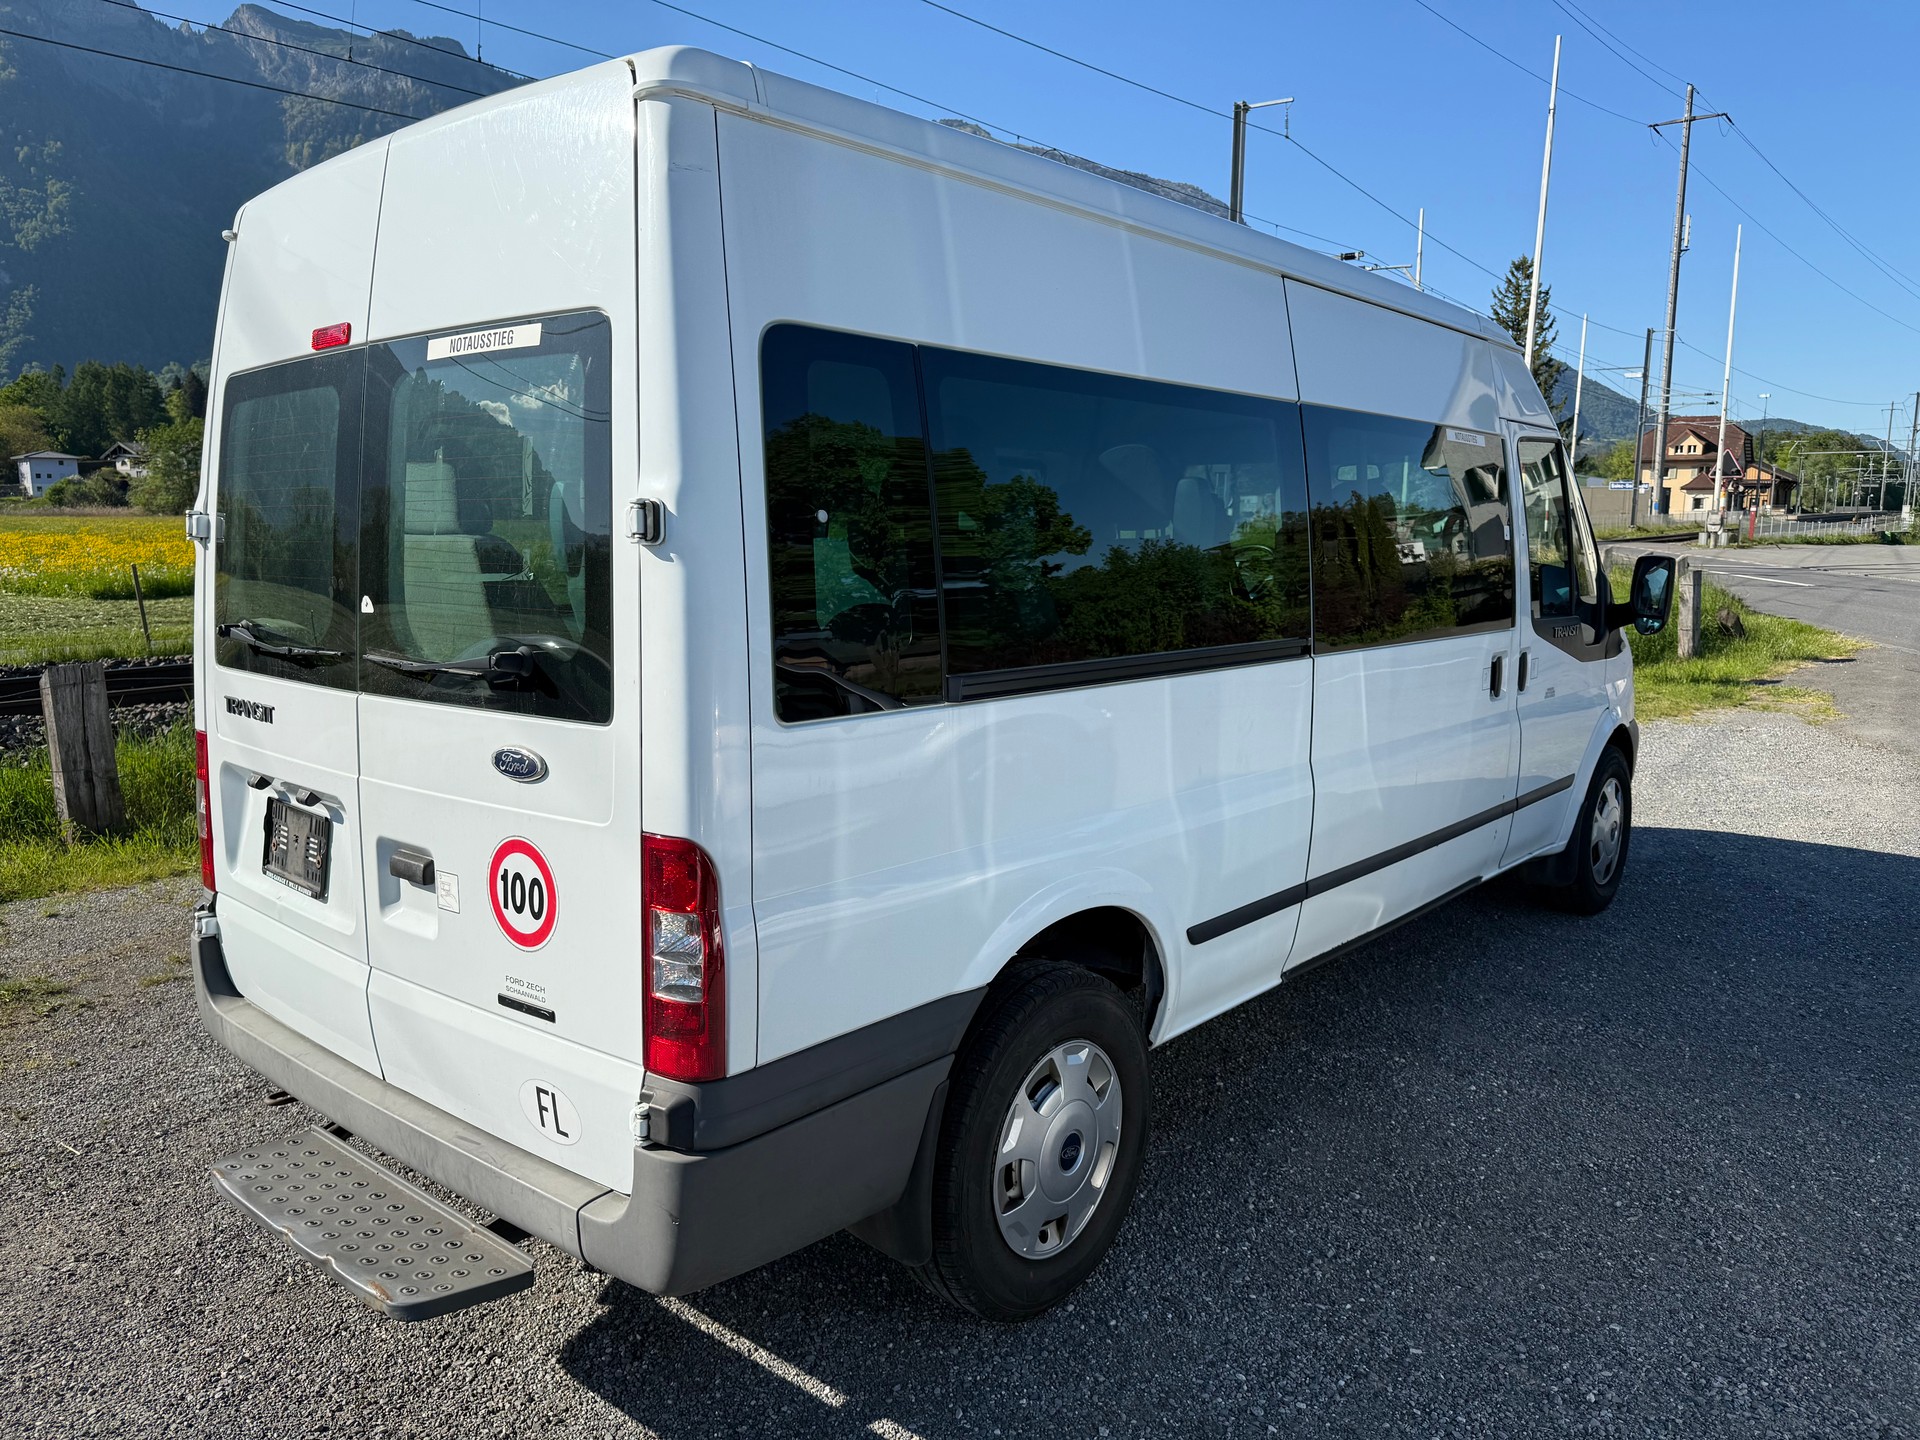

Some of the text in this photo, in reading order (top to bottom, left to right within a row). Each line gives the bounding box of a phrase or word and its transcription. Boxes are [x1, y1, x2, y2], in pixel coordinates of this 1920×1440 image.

[449, 329, 514, 354] NOTAUSSTIEG
[1553, 624, 1580, 638] TRANSIT
[224, 695, 275, 725] TRANSIT
[499, 751, 529, 774] Ford
[500, 868, 545, 921] 100
[505, 975, 546, 994] FORD ZECH
[505, 985, 547, 1004] SCHAANWALD
[535, 1085, 570, 1138] FL
